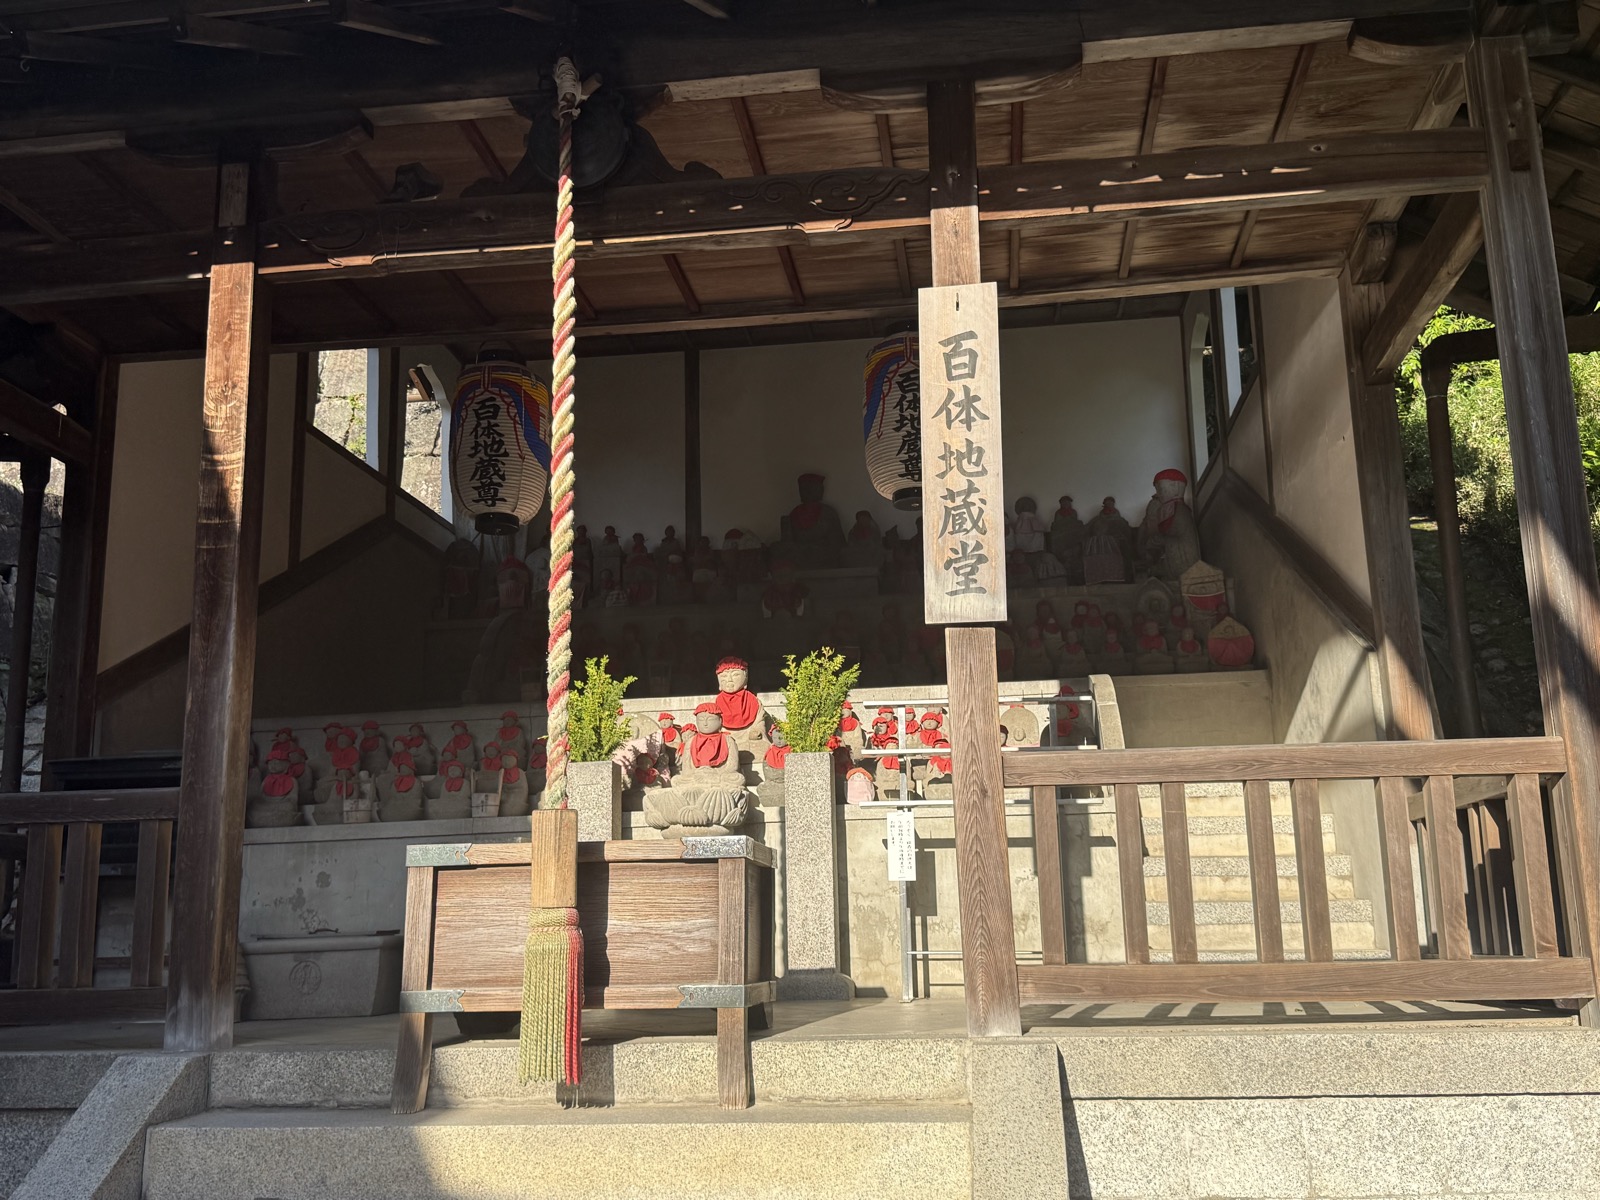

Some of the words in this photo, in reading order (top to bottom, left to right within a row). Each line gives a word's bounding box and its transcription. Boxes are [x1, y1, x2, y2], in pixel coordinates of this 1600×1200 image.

[467, 396, 509, 508] 百体地蔵尊
[931, 330, 991, 597] 百体地蔵堂
